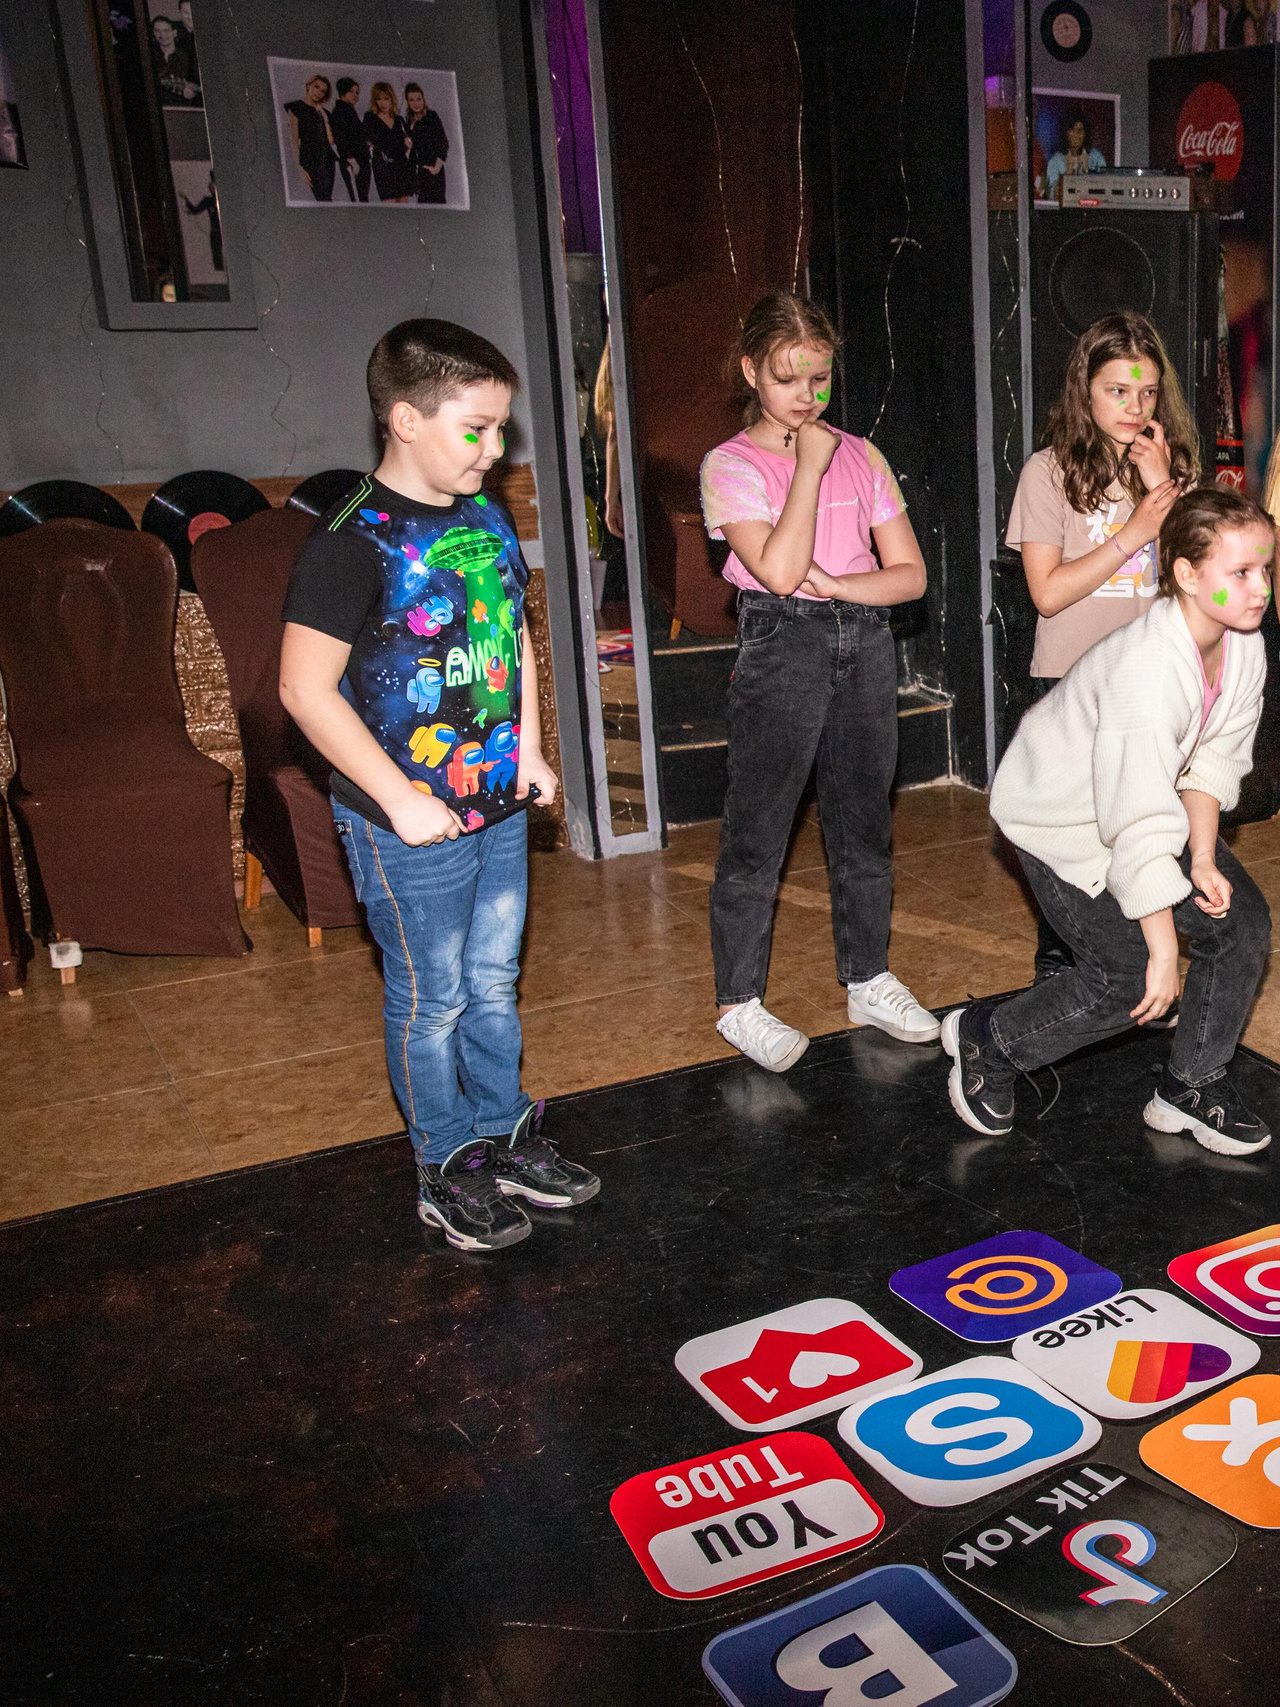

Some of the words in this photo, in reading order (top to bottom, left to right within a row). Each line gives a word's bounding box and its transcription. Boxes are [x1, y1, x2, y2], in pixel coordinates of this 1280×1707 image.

[1179, 121, 1240, 158] Coca-Cola
[1032, 1295, 1158, 1349] Likee
[655, 1446, 804, 1508] Tube
[1035, 1467, 1127, 1514] Tik
[691, 1500, 838, 1564] You
[943, 1515, 1053, 1570] Tok
